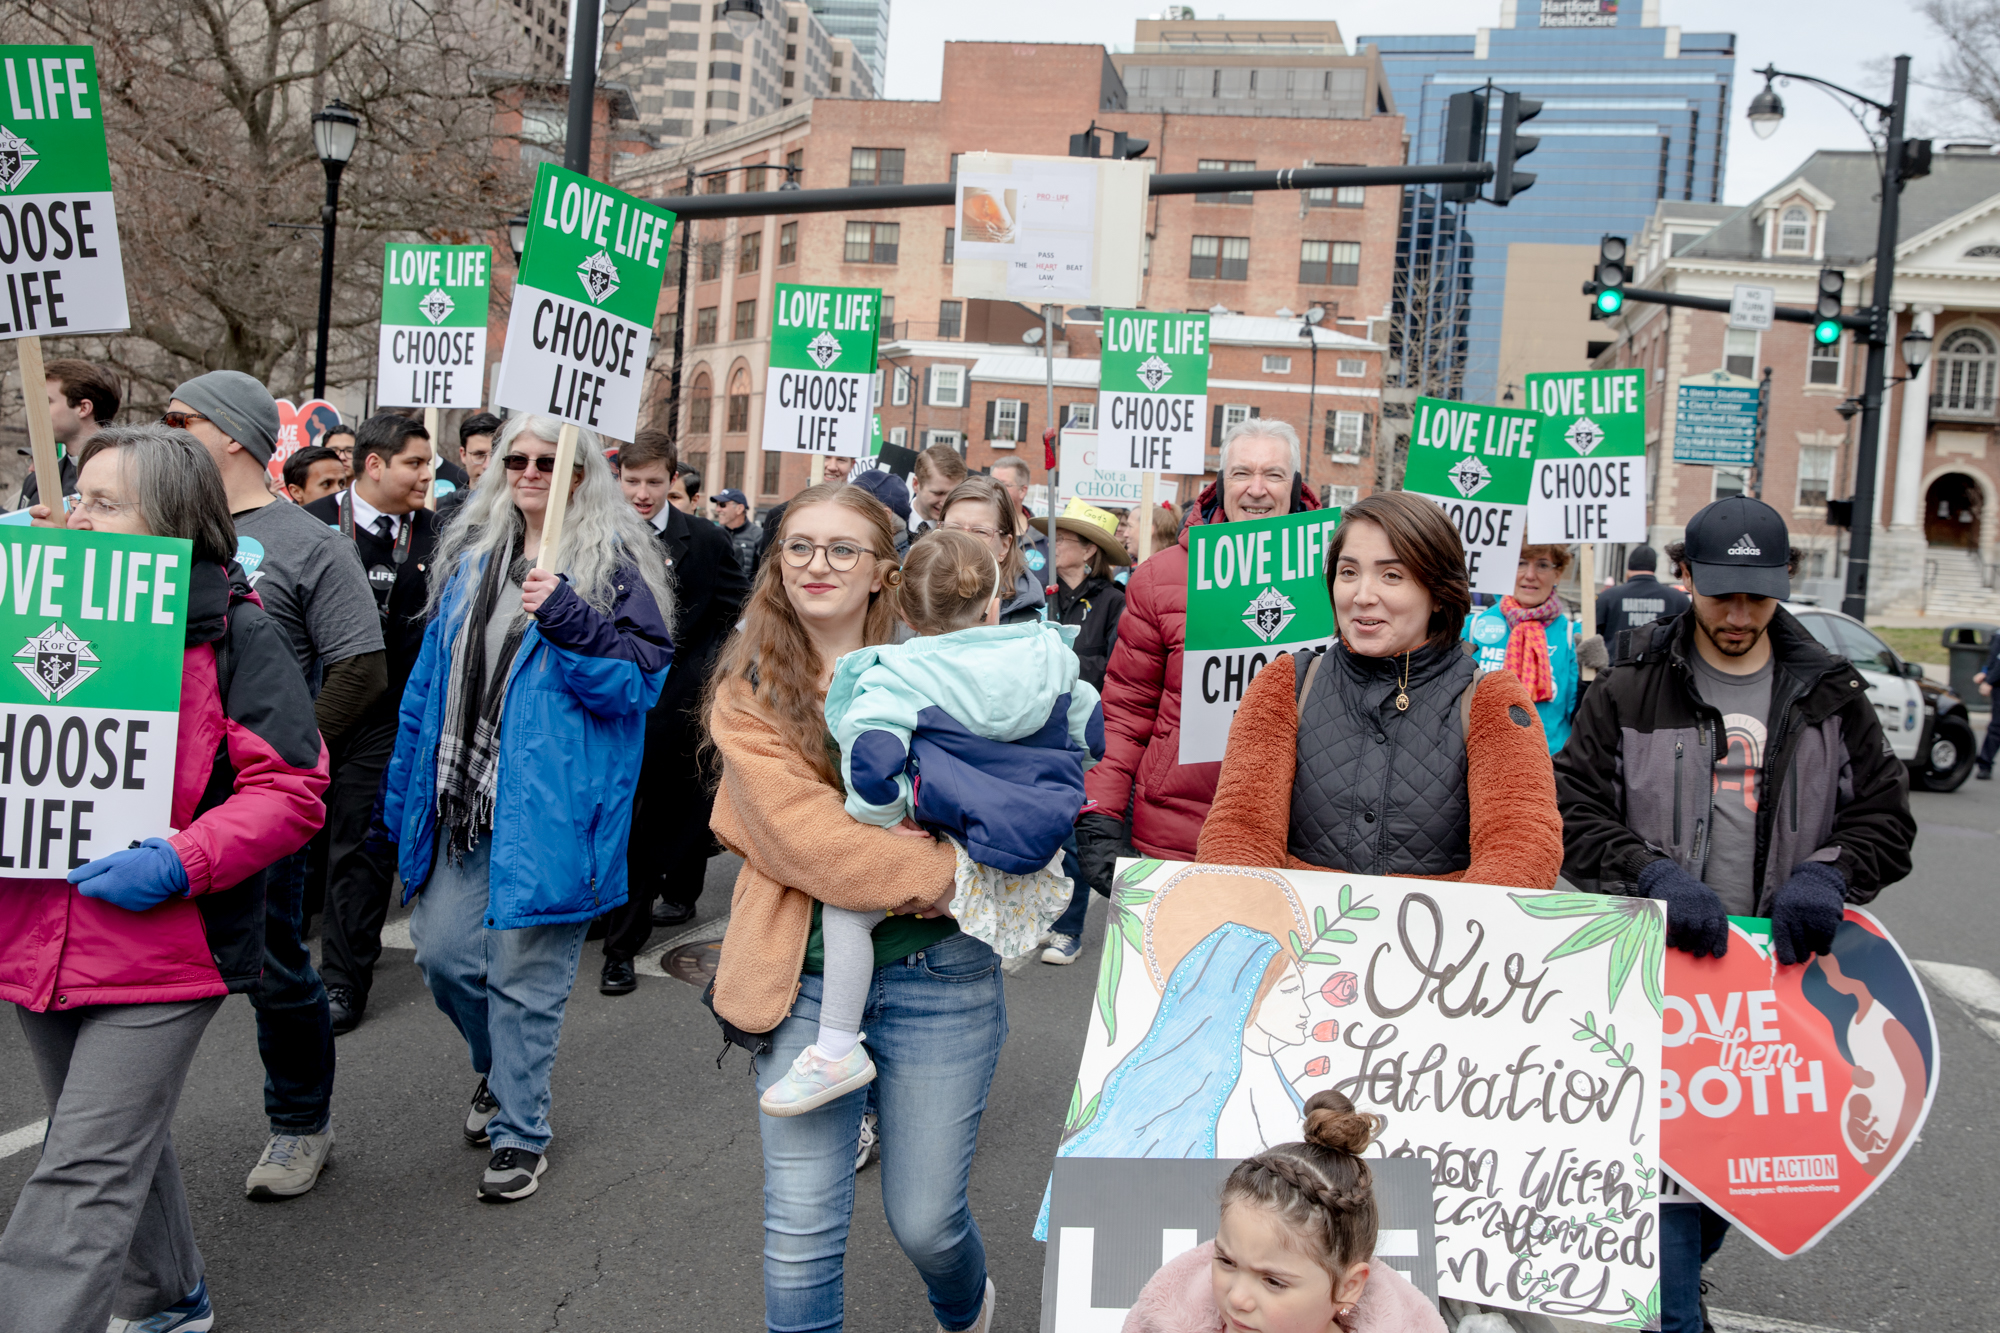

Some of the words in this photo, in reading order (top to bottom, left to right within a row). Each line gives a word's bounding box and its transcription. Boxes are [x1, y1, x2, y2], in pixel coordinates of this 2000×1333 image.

[1540, 13, 1618, 26] HealthCare
[1541, 0, 1599, 12] Hartford
[5, 58, 92, 120] LIFE
[0, 200, 98, 265] OOSE
[543, 175, 614, 247] LOVE
[614, 203, 668, 268] LIFE
[390, 250, 441, 286] LOVE
[446, 252, 486, 287] LIFE
[778, 290, 830, 329] LOVE
[834, 294, 872, 331] LIFE
[392, 330, 475, 366] CHOOSE
[533, 298, 638, 378] CHOOSE
[1108, 317, 1158, 353] LOVE
[1164, 320, 1205, 355] LIFE
[412, 370, 453, 404] LIFE
[548, 363, 606, 427] LIFE
[780, 373, 859, 413] CHOOSE
[1592, 376, 1638, 414] LIFE
[278, 424, 298, 441] VE
[1112, 396, 1194, 432] CHOOSE
[1417, 405, 1481, 454] LOVE
[1483, 415, 1537, 459] LIFE
[797, 415, 838, 452] LIFE
[851, 458, 876, 478] OOS
[1130, 436, 1172, 470] LIFE
[1076, 481, 1142, 498] CHOICE
[1094, 469, 1117, 482] Not
[1540, 462, 1631, 499] CHOOSE
[399, 523, 409, 546] Canon
[1443, 503, 1512, 547] OOSE
[1565, 504, 1608, 539] LIFE
[1197, 530, 1272, 590] LOVE
[1728, 546, 1761, 556] adidas
[0, 542, 67, 617] VE
[80, 548, 178, 624] LIFE
[369, 571, 395, 582] LIFE
[39, 641, 50, 652] K
[51, 642, 64, 650] OF
[67, 642, 77, 653] C
[1364, 892, 1563, 1023] Our
[1662, 990, 1781, 1047] OVE
[1688, 1027, 1804, 1070] them
[1660, 1060, 1828, 1120] BOTH
[1370, 1113, 1504, 1198] gan
[1519, 1147, 1642, 1219] With
[1727, 1157, 1773, 1183] LIVE
[1777, 1158, 1835, 1178] ACTION
[1729, 1187, 1776, 1196] Instagram:
